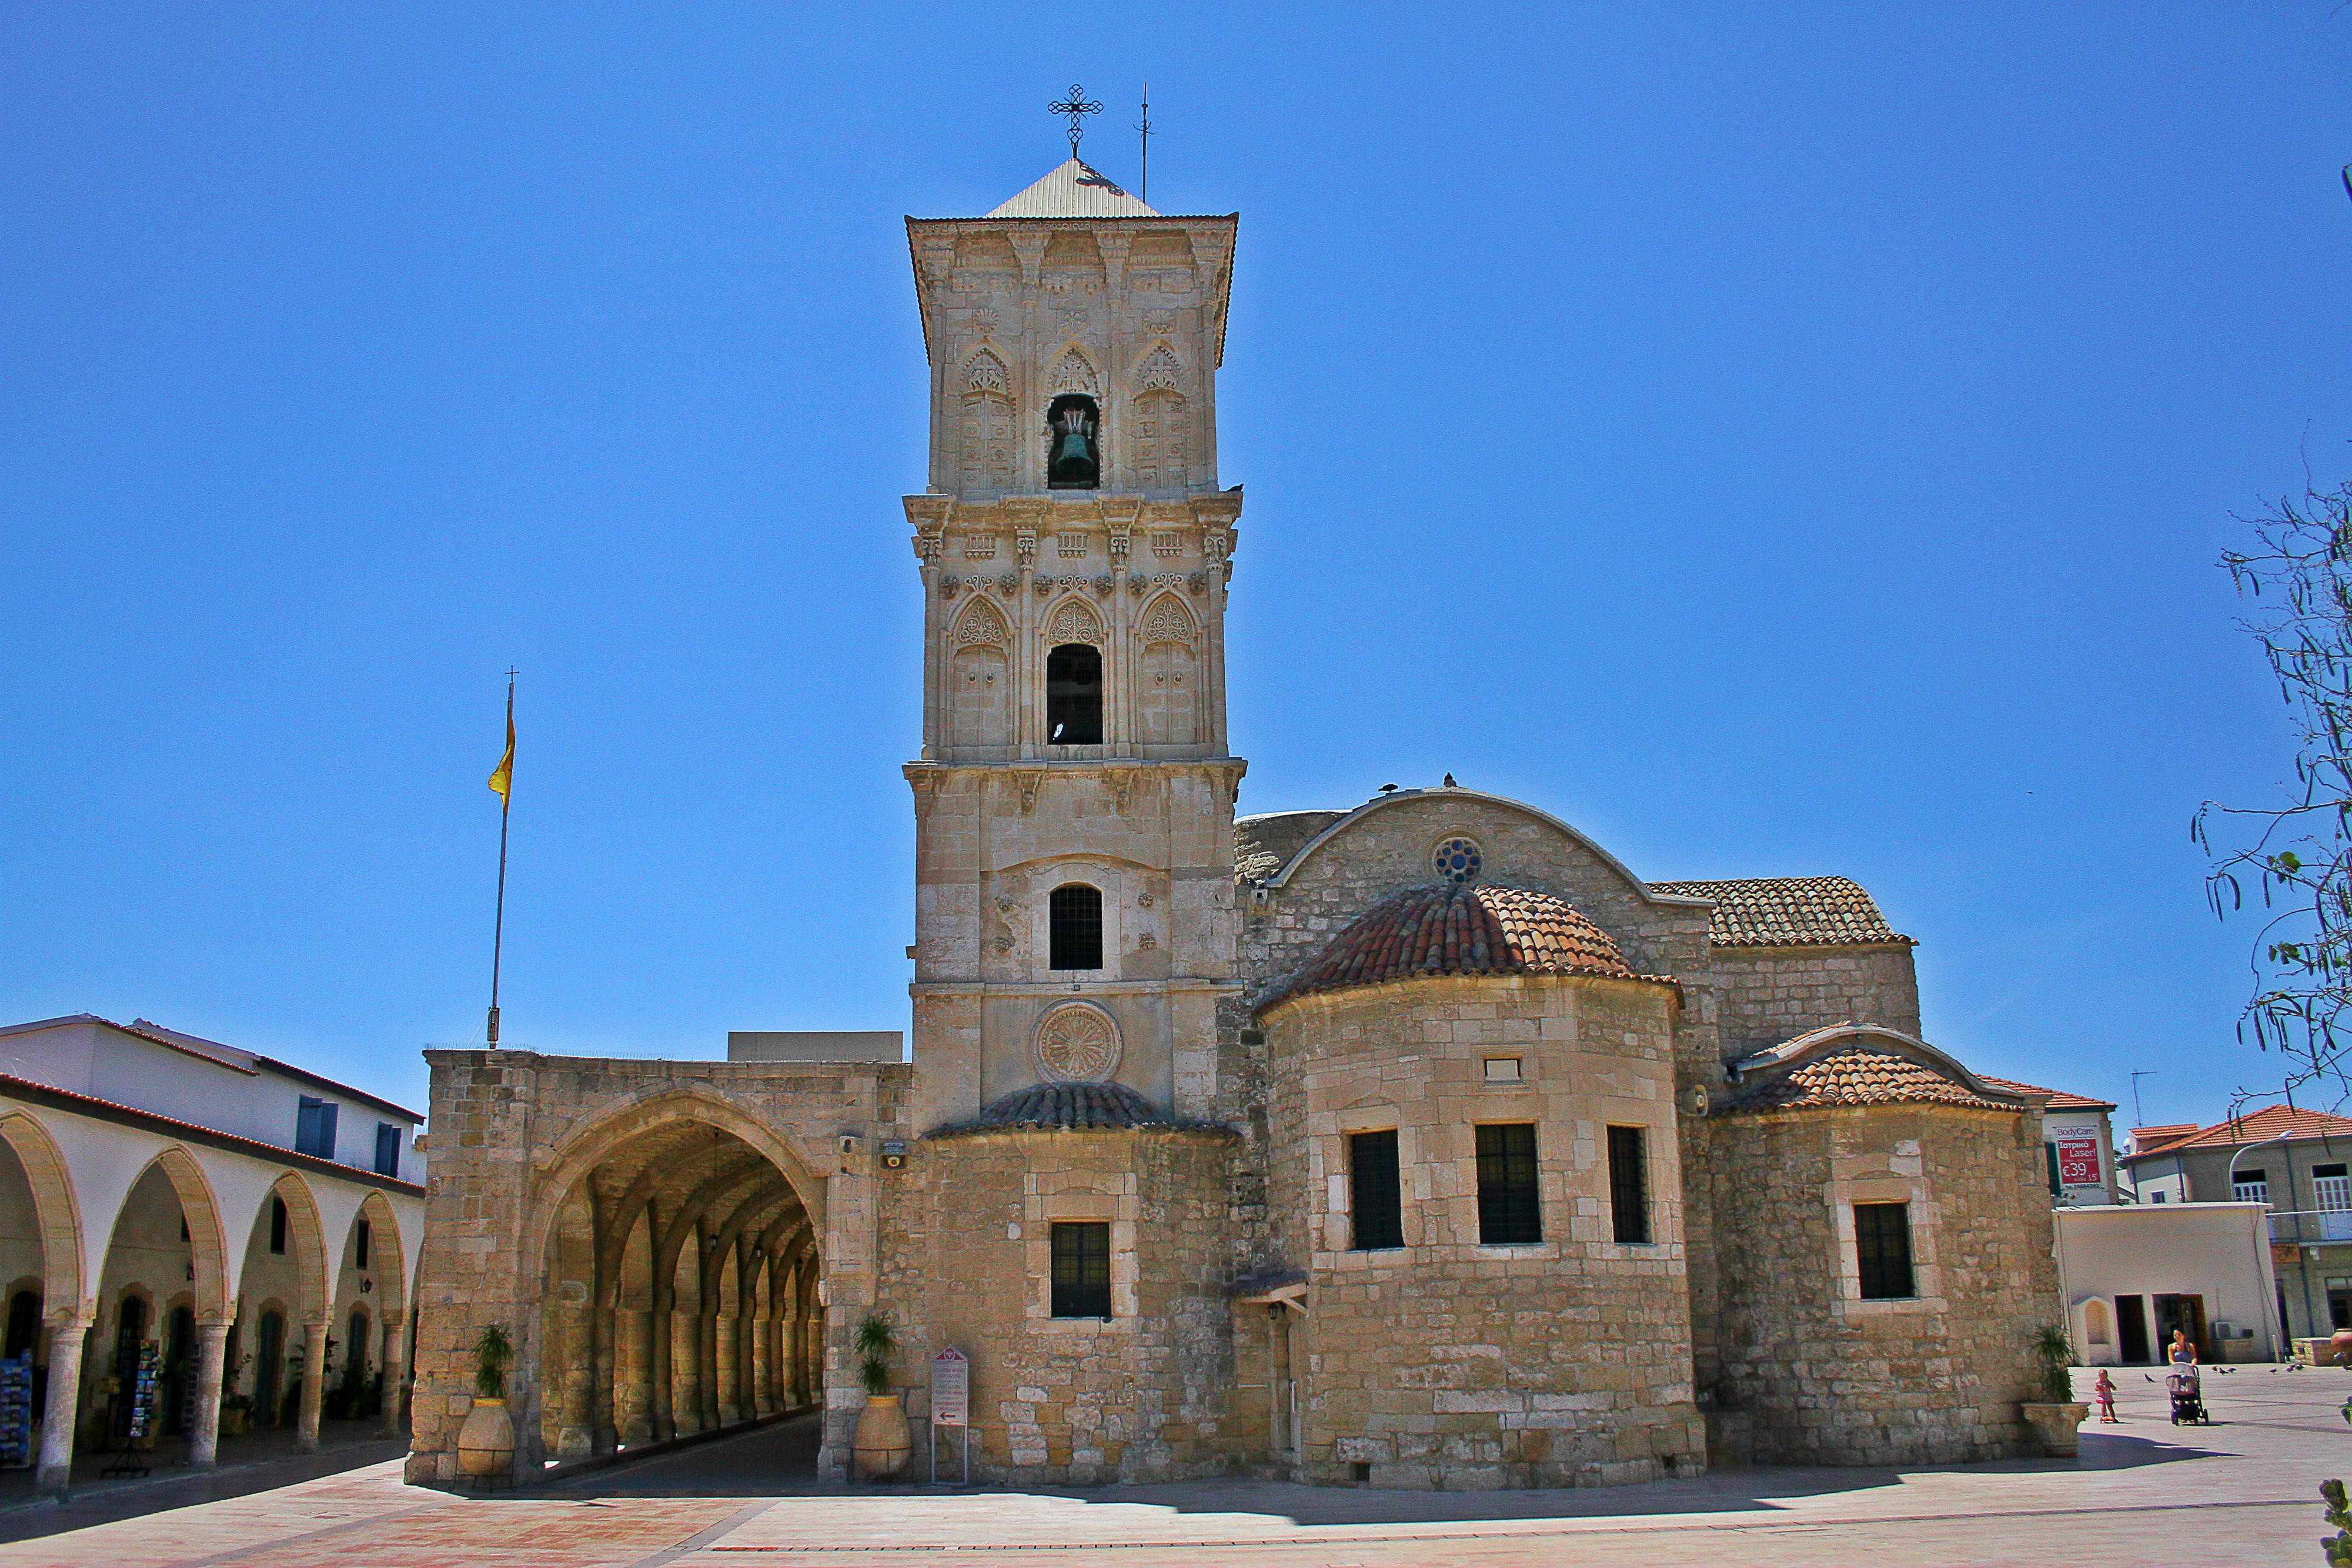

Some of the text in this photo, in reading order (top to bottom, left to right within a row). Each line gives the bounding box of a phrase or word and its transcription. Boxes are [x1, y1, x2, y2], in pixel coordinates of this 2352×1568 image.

[2057, 1128, 2094, 1136] BodyCare
[2059, 1140, 2089, 1149] Ιατρικό
[2070, 1148, 2096, 1157] Laser!
[2063, 1162, 2086, 1176] €39
